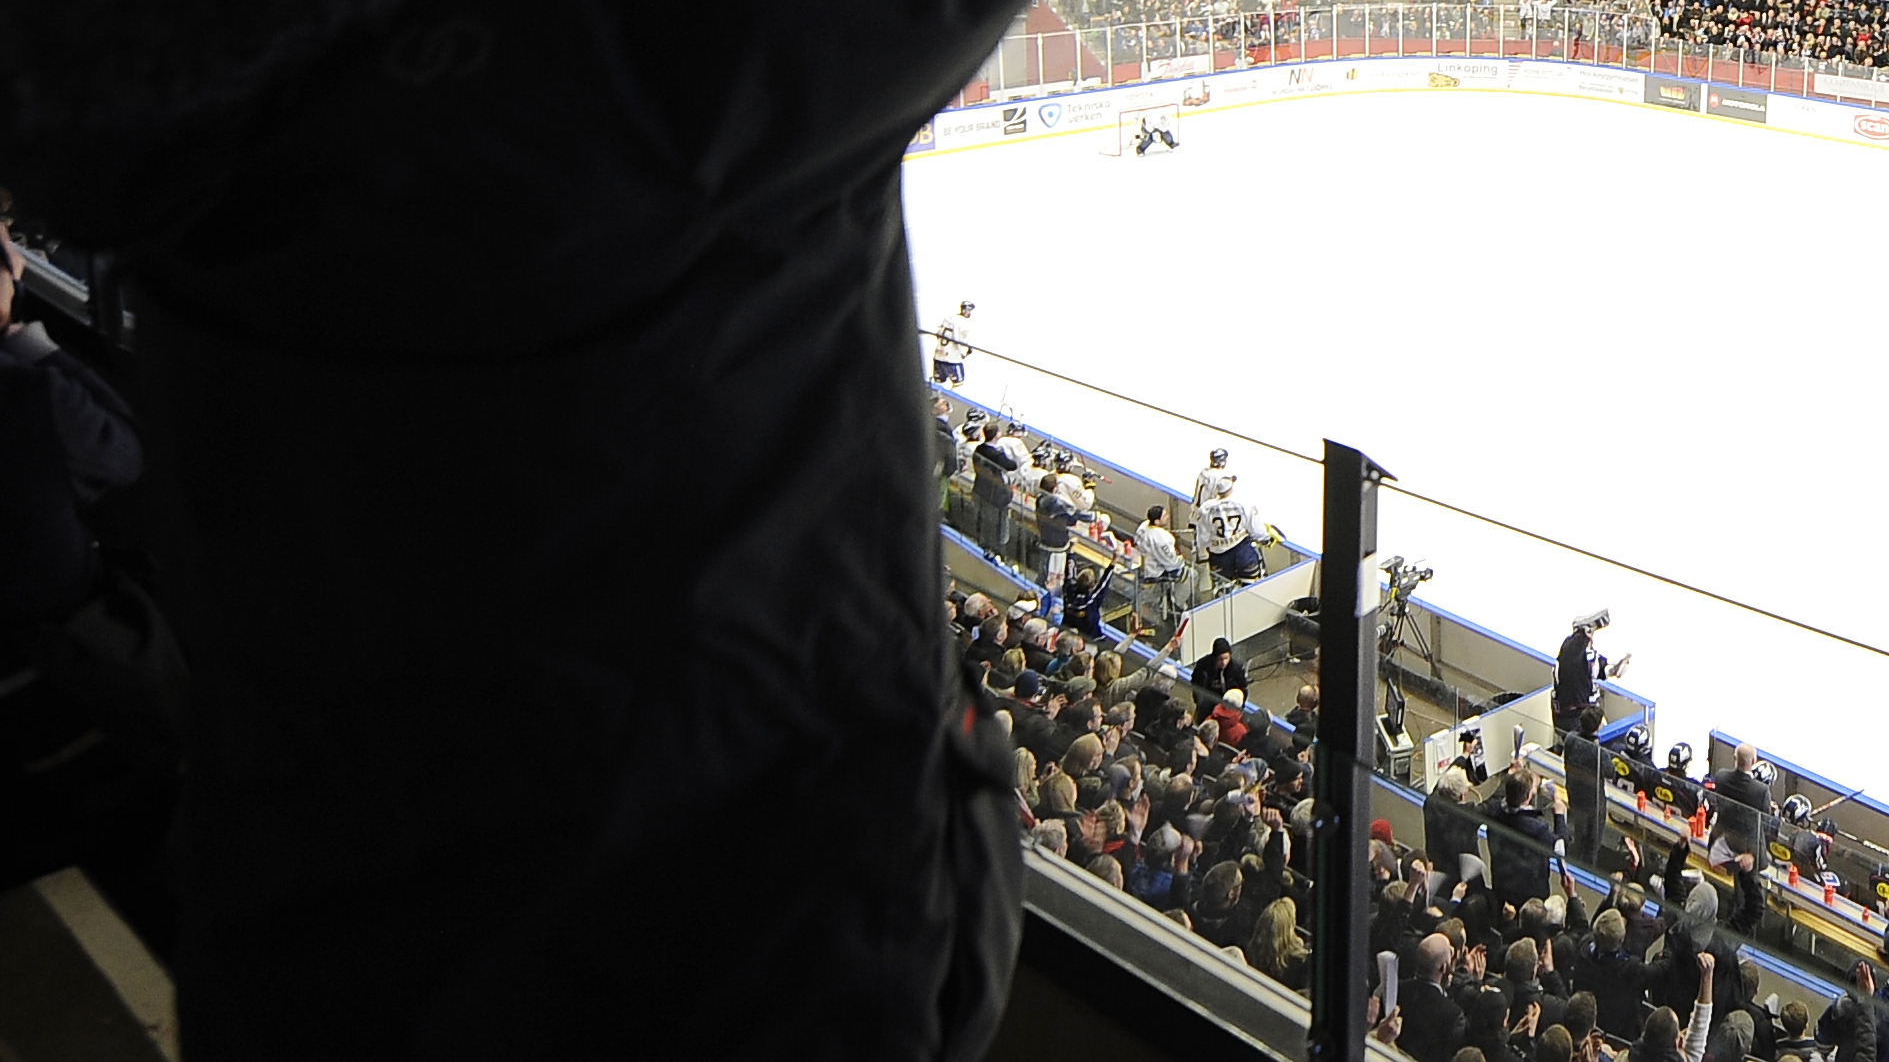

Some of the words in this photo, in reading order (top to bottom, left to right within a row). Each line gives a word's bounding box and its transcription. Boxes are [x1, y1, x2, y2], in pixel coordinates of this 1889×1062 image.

[1437, 62, 1498, 76] Linköping
[1124, 91, 1154, 101] TOYOTA
[1066, 100, 1111, 113] Tekniska
[1721, 98, 1766, 113] MOTOROLA
[1066, 111, 1102, 125] verken
[954, 123, 974, 136] YOUR
[975, 119, 1001, 133] BRAND
[1860, 119, 1889, 135] scan
[1212, 515, 1242, 538] 37
